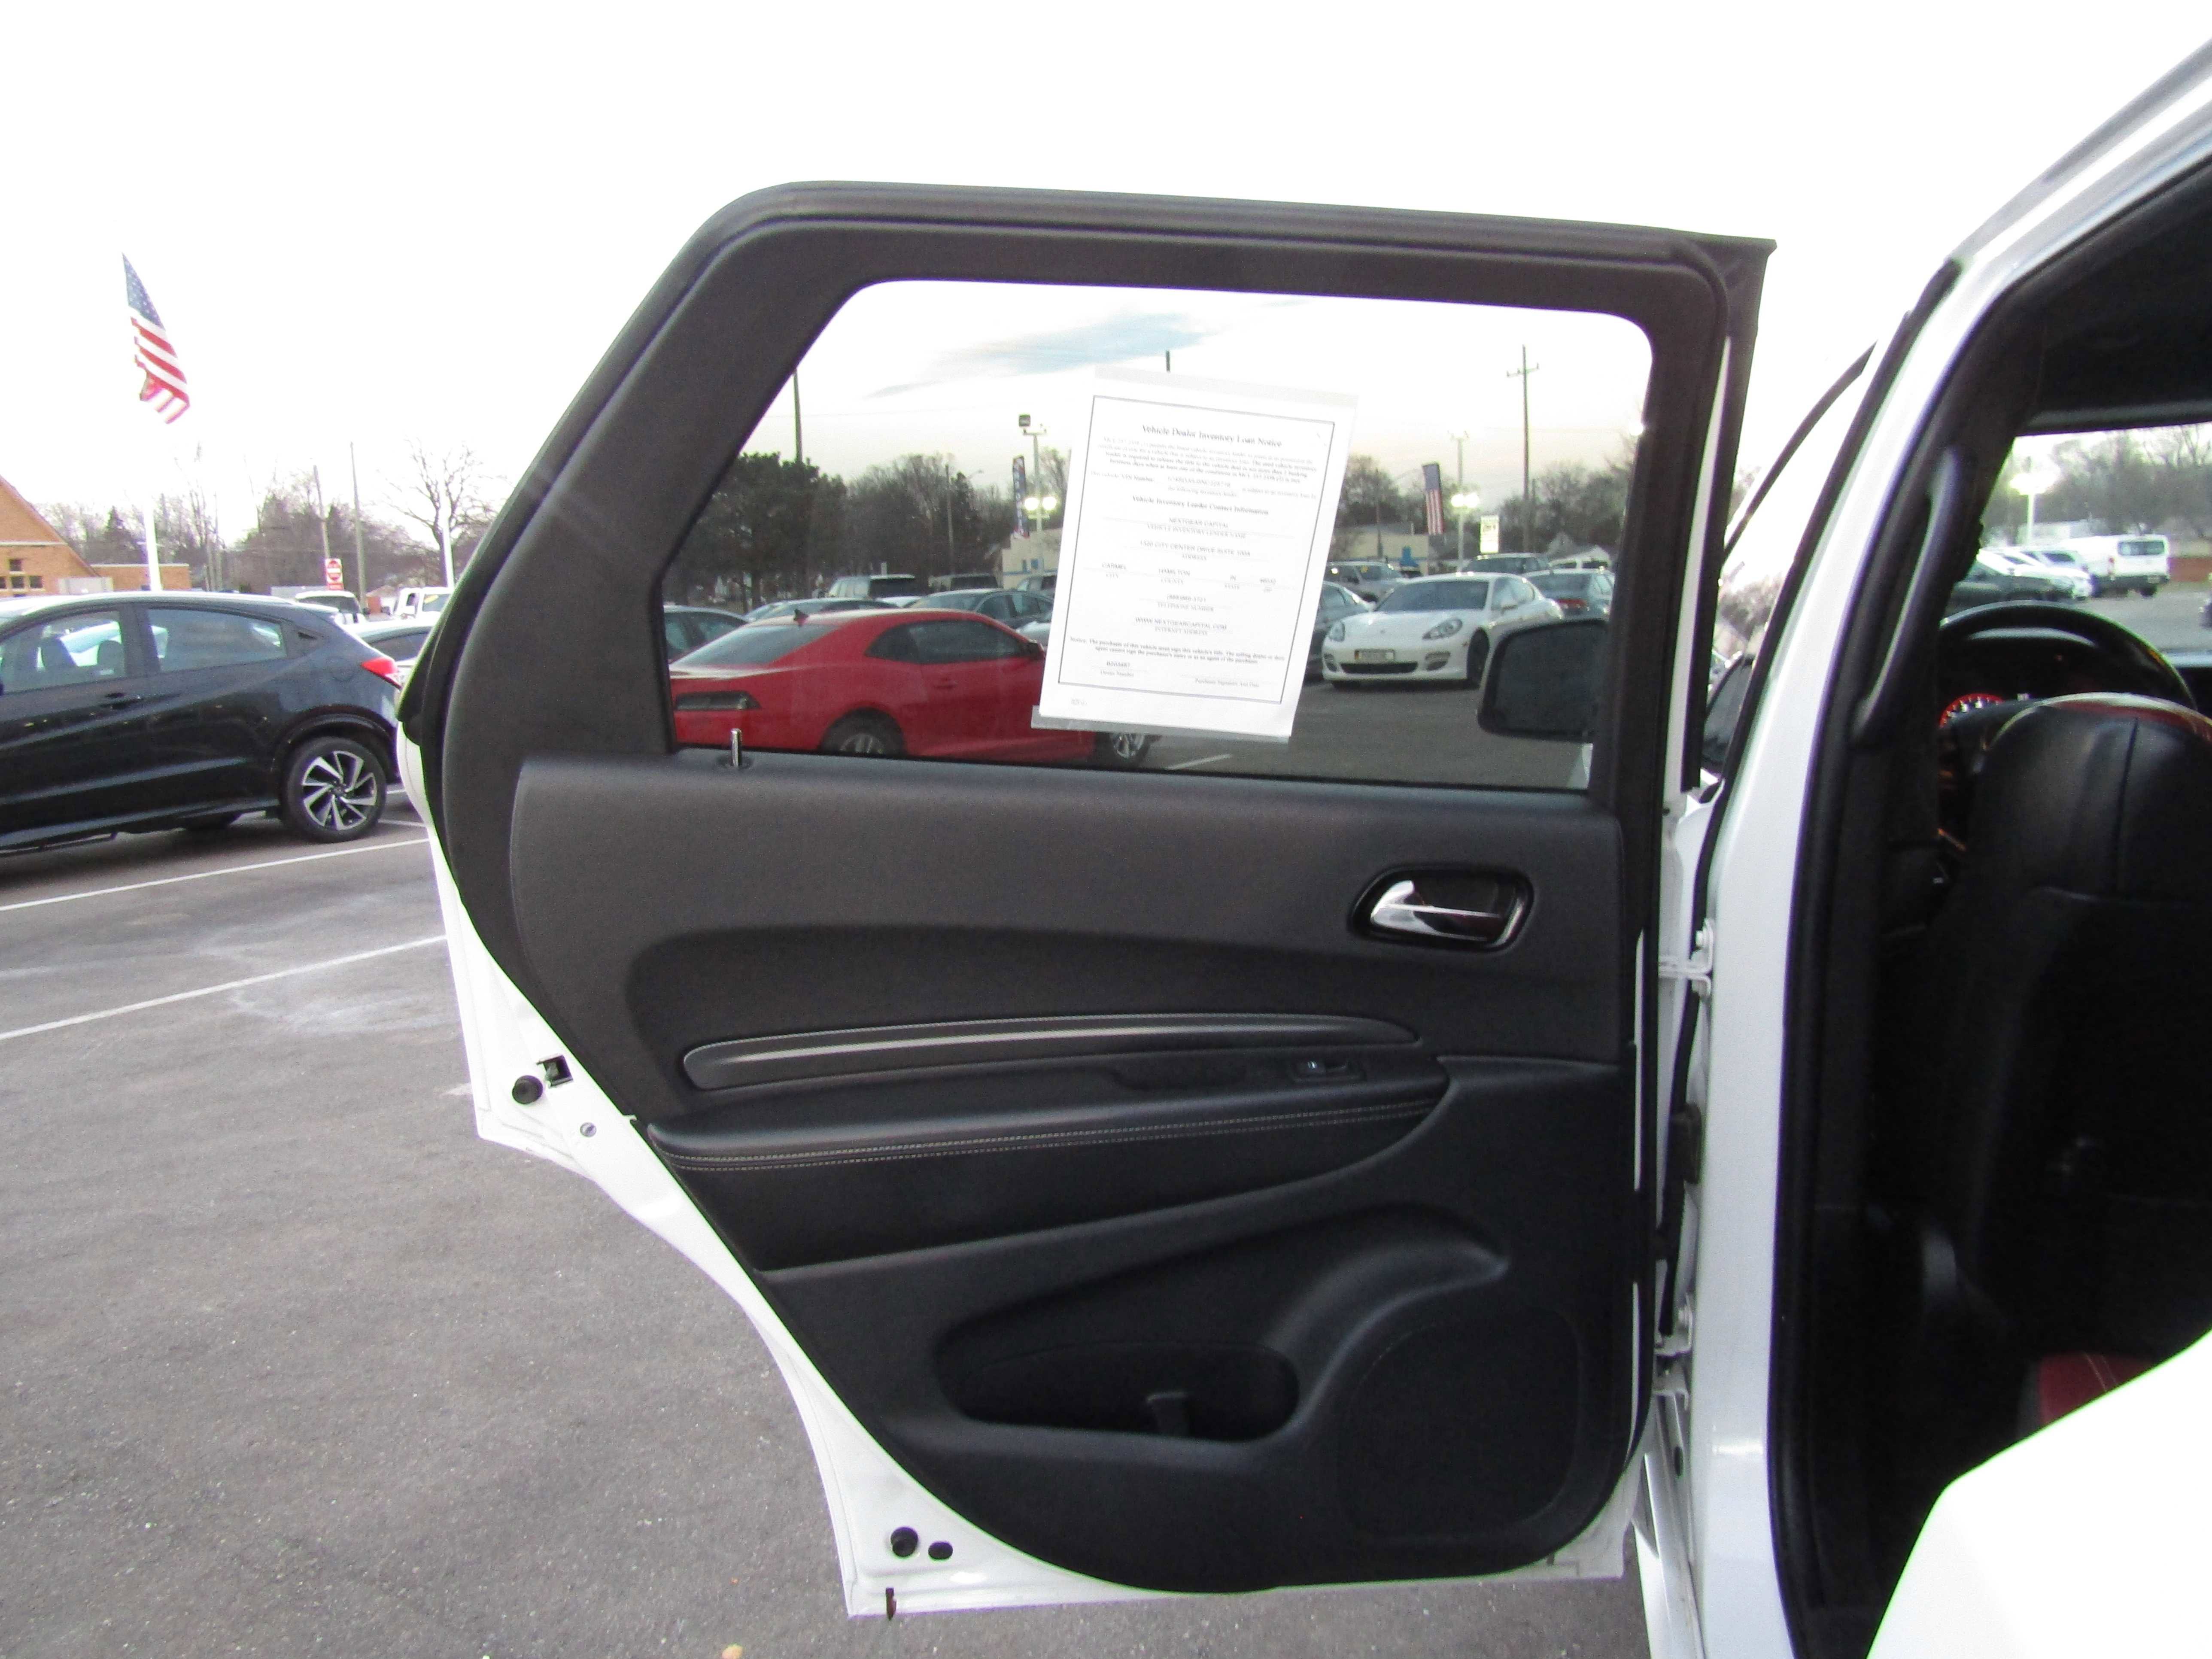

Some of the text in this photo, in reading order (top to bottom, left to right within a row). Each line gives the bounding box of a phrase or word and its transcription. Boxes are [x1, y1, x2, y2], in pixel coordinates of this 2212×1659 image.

[1142, 425, 1282, 447] Vehicle Dealer Inventory Loan Notice
[1157, 498, 1185, 507] Inventory
[1234, 506, 1269, 515] Information
[1170, 543, 1196, 551] CENTER
